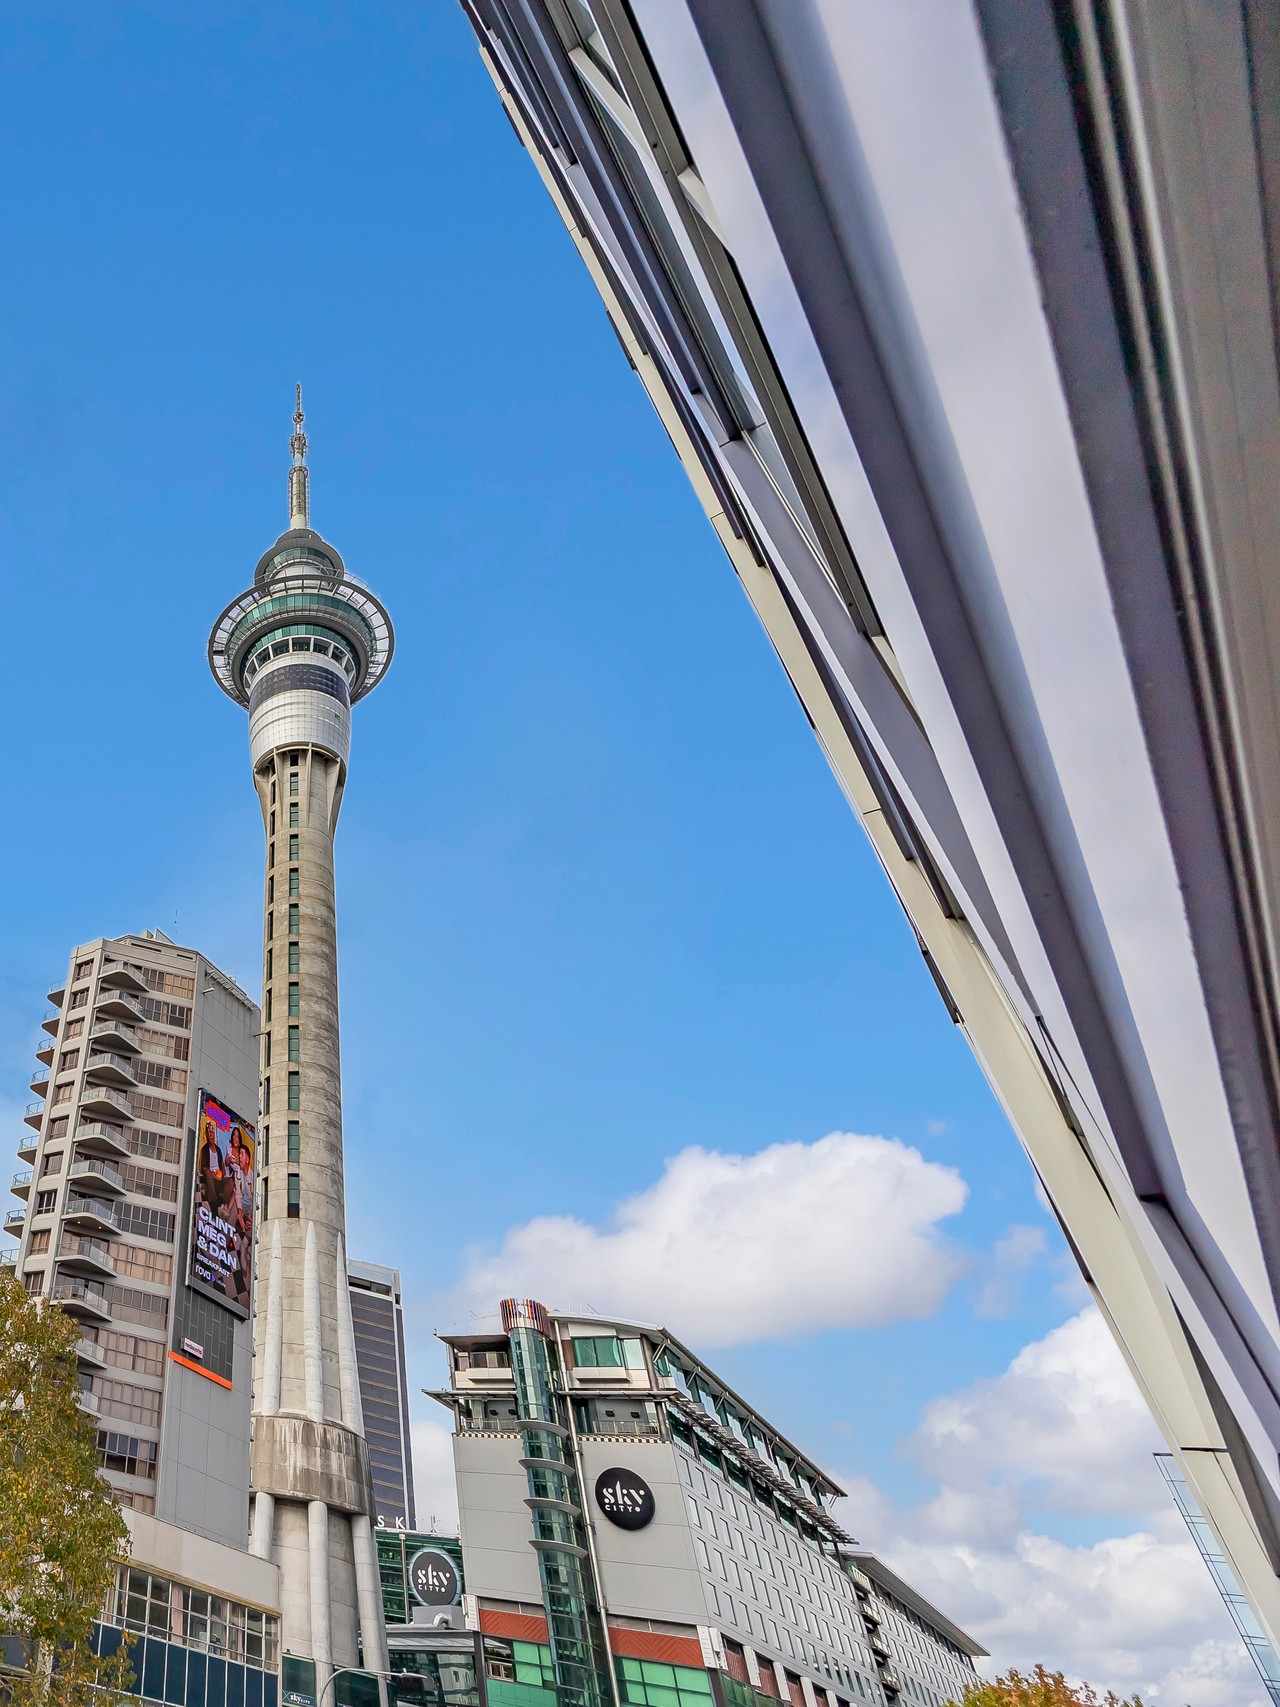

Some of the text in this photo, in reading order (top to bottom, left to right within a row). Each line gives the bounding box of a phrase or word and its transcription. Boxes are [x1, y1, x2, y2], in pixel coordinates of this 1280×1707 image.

[198, 1220, 227, 1248] MEG
[199, 1206, 236, 1241] CLINT,
[196, 1252, 231, 1277] BREAKFAST
[197, 1235, 237, 1269] & DAN
[605, 1504, 633, 1512] CITY
[418, 1584, 440, 1592] CITY
